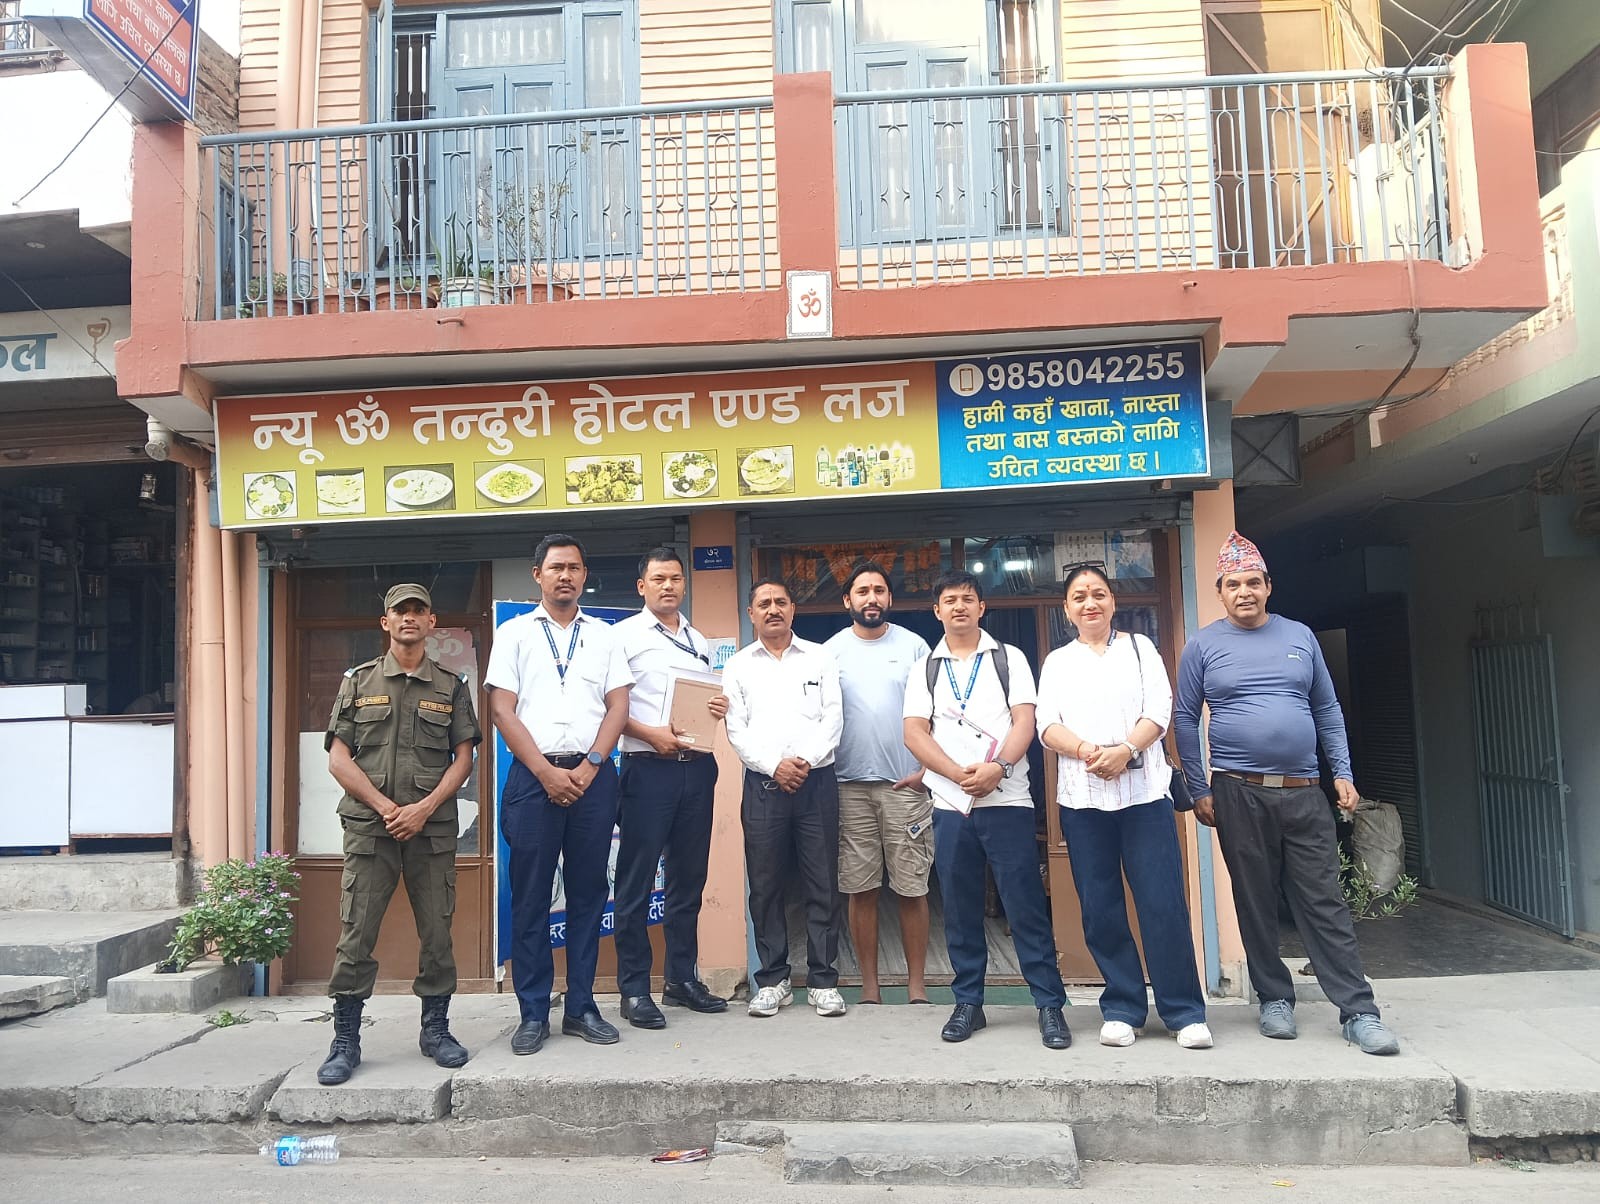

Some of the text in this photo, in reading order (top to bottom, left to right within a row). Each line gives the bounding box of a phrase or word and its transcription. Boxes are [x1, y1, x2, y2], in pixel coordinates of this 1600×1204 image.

[987, 351, 1184, 391] 9858042255
[250, 411, 325, 465] न्यू
[410, 386, 555, 456] तन्दुरी
[570, 383, 695, 445] होटल
[709, 385, 805, 428] एण्ड
[820, 379, 909, 423] लज
[962, 393, 1181, 429] हामी कहाँ खाना, नास्ता
[965, 417, 1180, 453] तथा बास बस्नको लागि
[987, 455, 1039, 478] उचित
[1045, 453, 1121, 475] व्यवस्था
